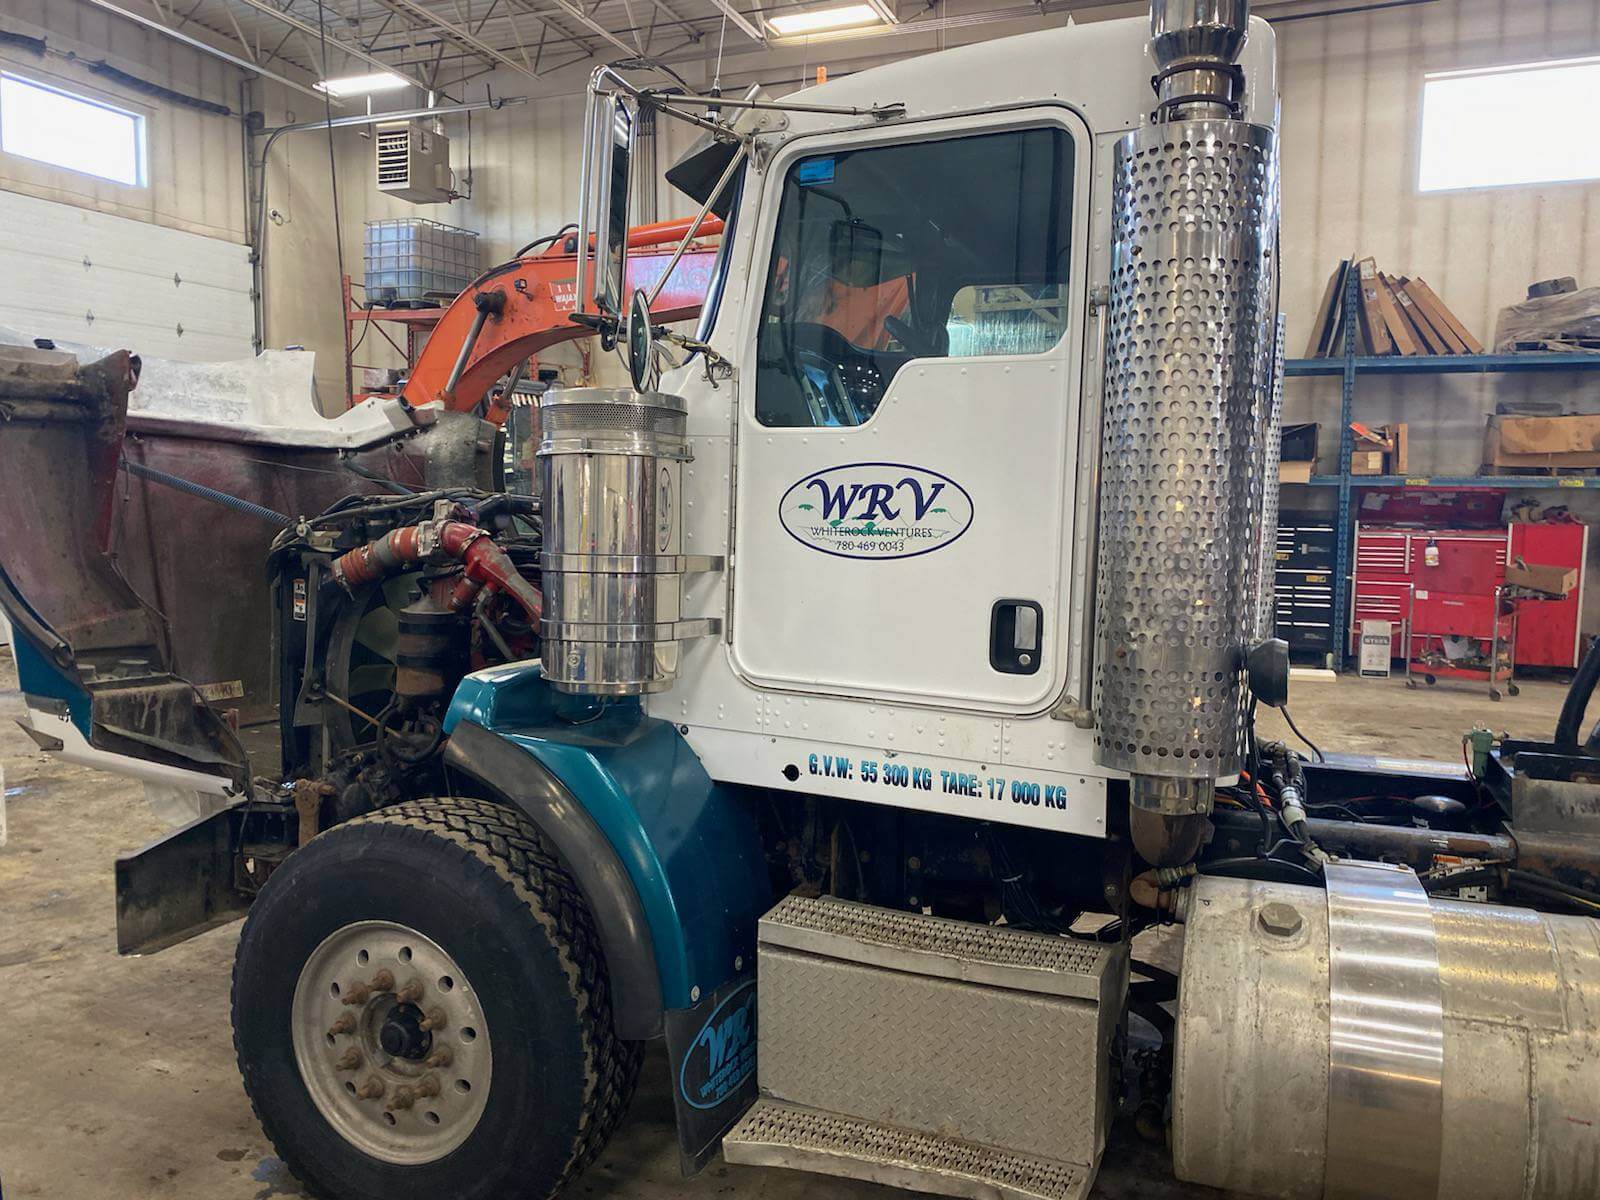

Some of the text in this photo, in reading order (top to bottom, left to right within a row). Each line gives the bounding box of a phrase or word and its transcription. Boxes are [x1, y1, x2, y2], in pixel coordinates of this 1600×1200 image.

[806, 477, 945, 521] WRV
[836, 541, 904, 551] 780-469 0043
[877, 527, 933, 538] VENTURES
[809, 753, 1067, 810] G.V.W: 55 300 KG TARE: 17 000 KG
